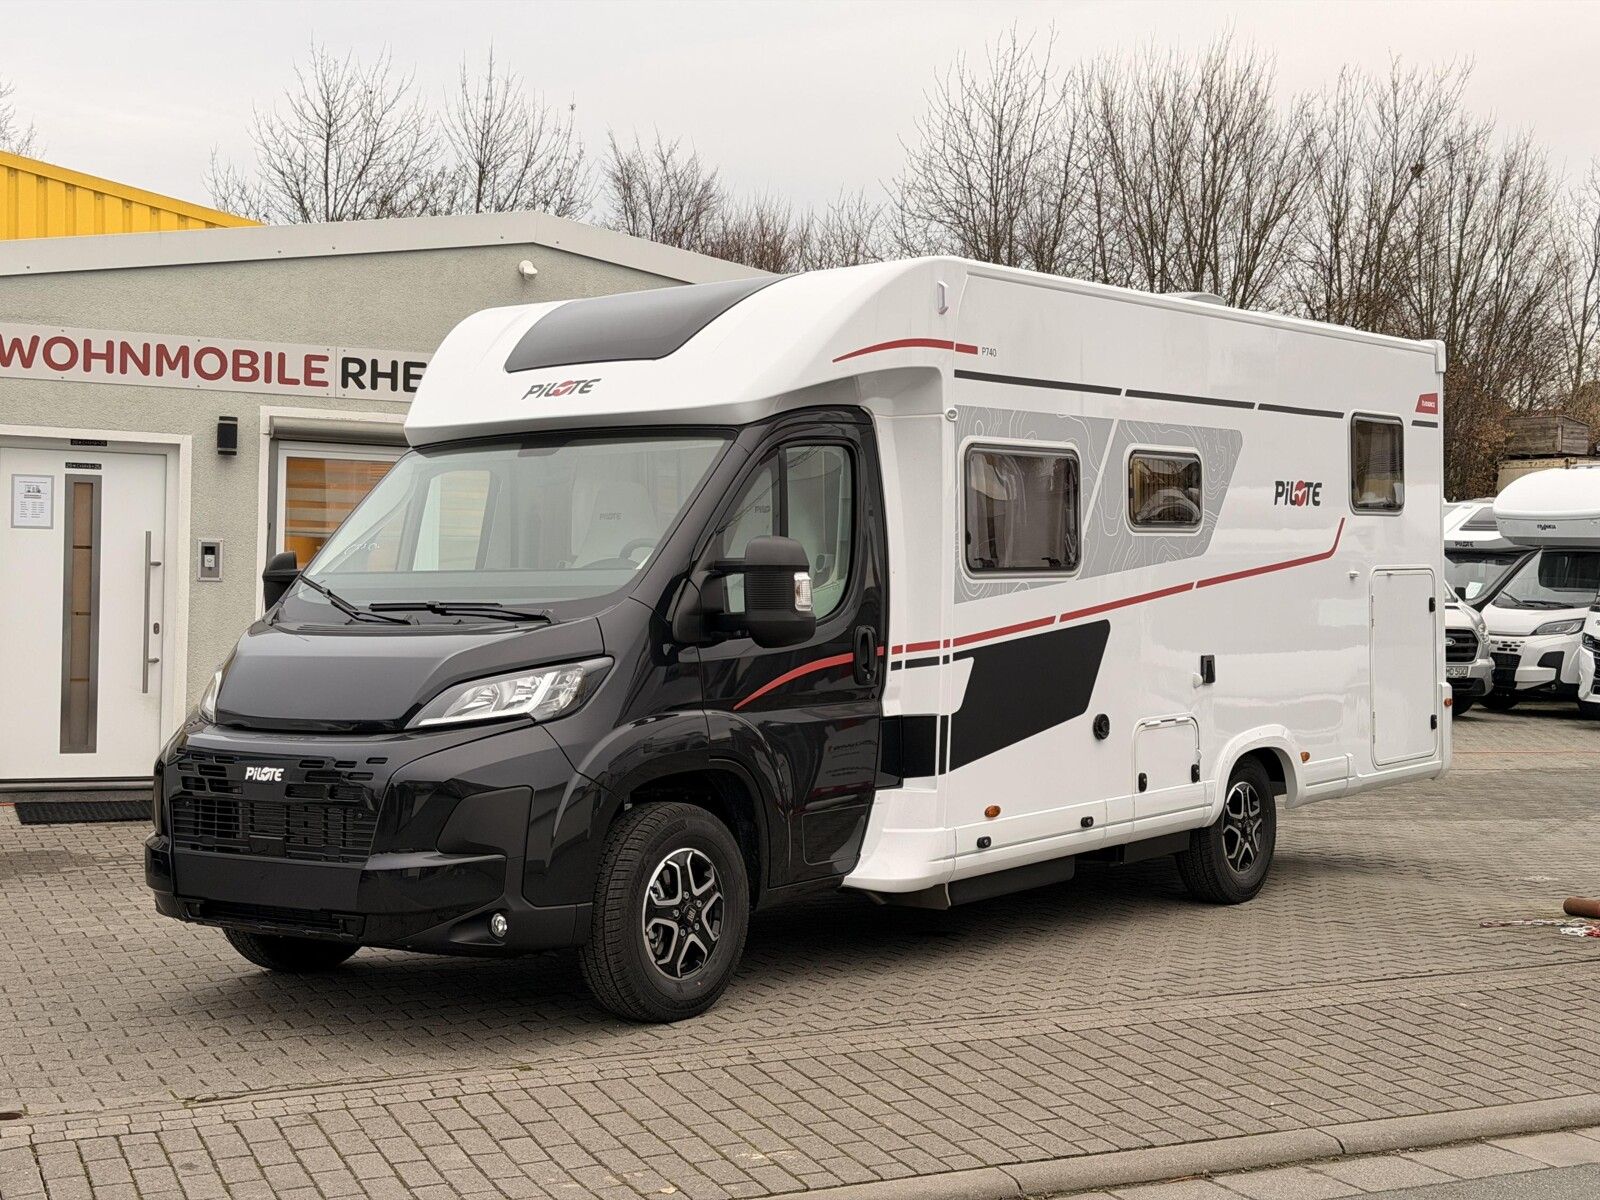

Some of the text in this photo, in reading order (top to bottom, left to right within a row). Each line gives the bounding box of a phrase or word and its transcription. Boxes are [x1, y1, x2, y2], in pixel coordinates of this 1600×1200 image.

[0, 334, 427, 392] WOHNMOBILE RHE
[982, 346, 997, 357] P740
